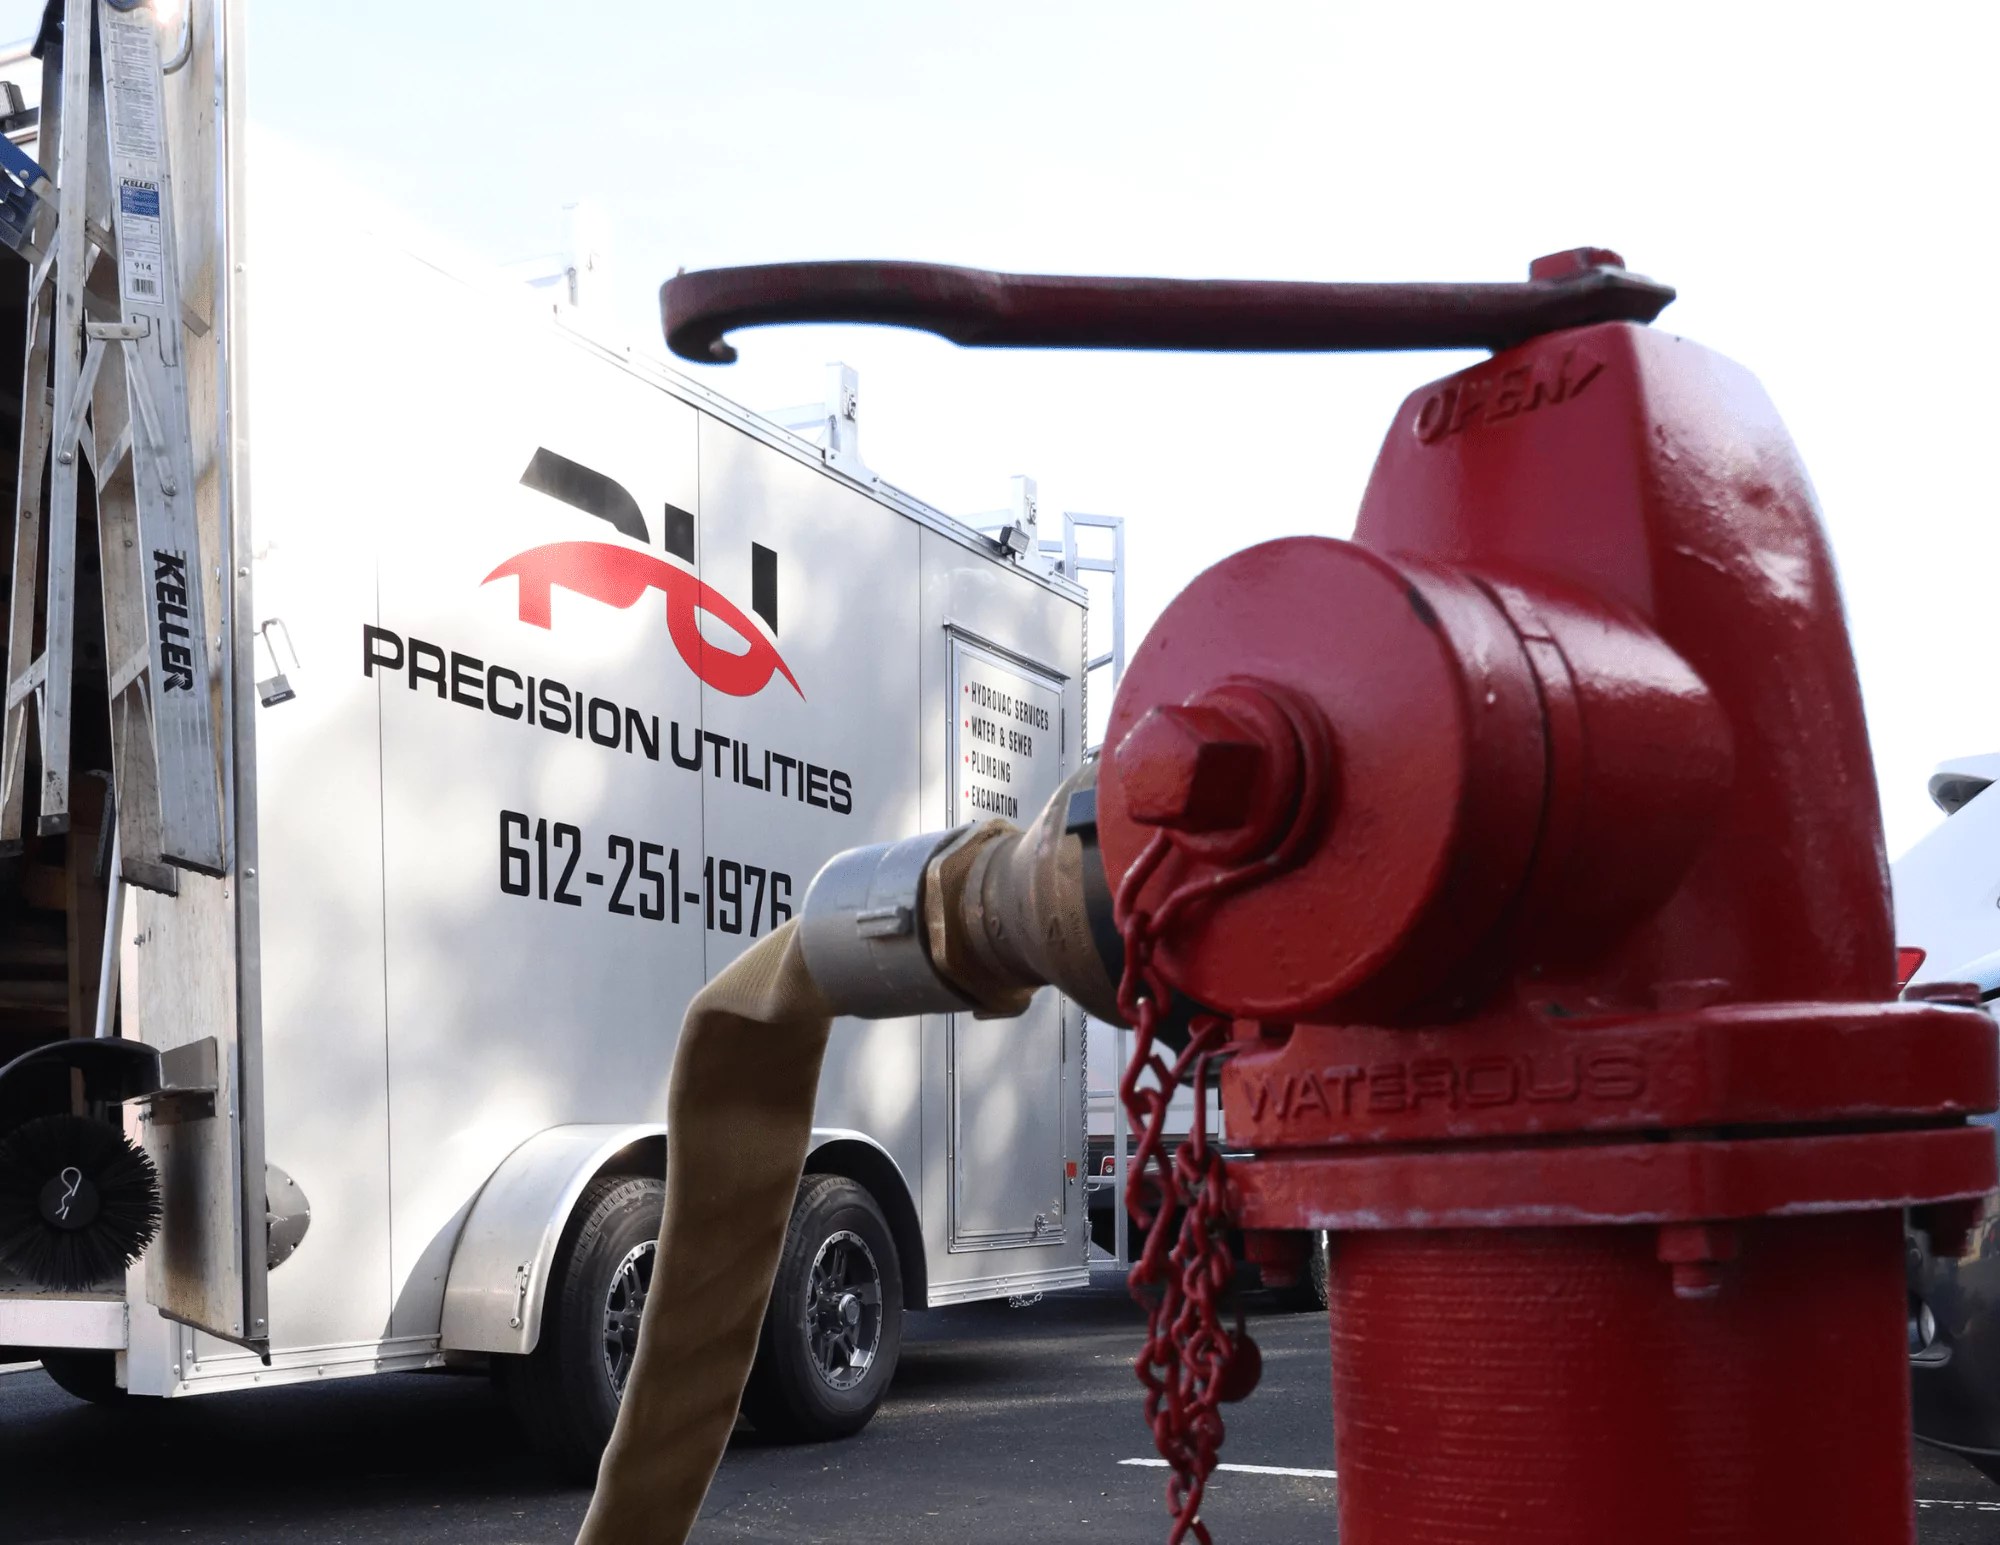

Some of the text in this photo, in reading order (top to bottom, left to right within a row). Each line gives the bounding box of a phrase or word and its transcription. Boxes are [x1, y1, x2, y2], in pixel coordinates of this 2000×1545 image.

[123, 179, 156, 190] KELLER
[134, 262, 152, 271] 914
[153, 549, 194, 693] KELLER
[363, 623, 853, 815] PRECISION UTILITIES
[971, 681, 1049, 731] HYDROVAC SERVICES
[971, 715, 1033, 758] WATER & SEWER
[971, 750, 1011, 783] PLUMBING
[971, 785, 1018, 819] EXCAVATION
[499, 809, 792, 938] 612-251-1976
[1240, 1047, 1646, 1122] WATEROUS
